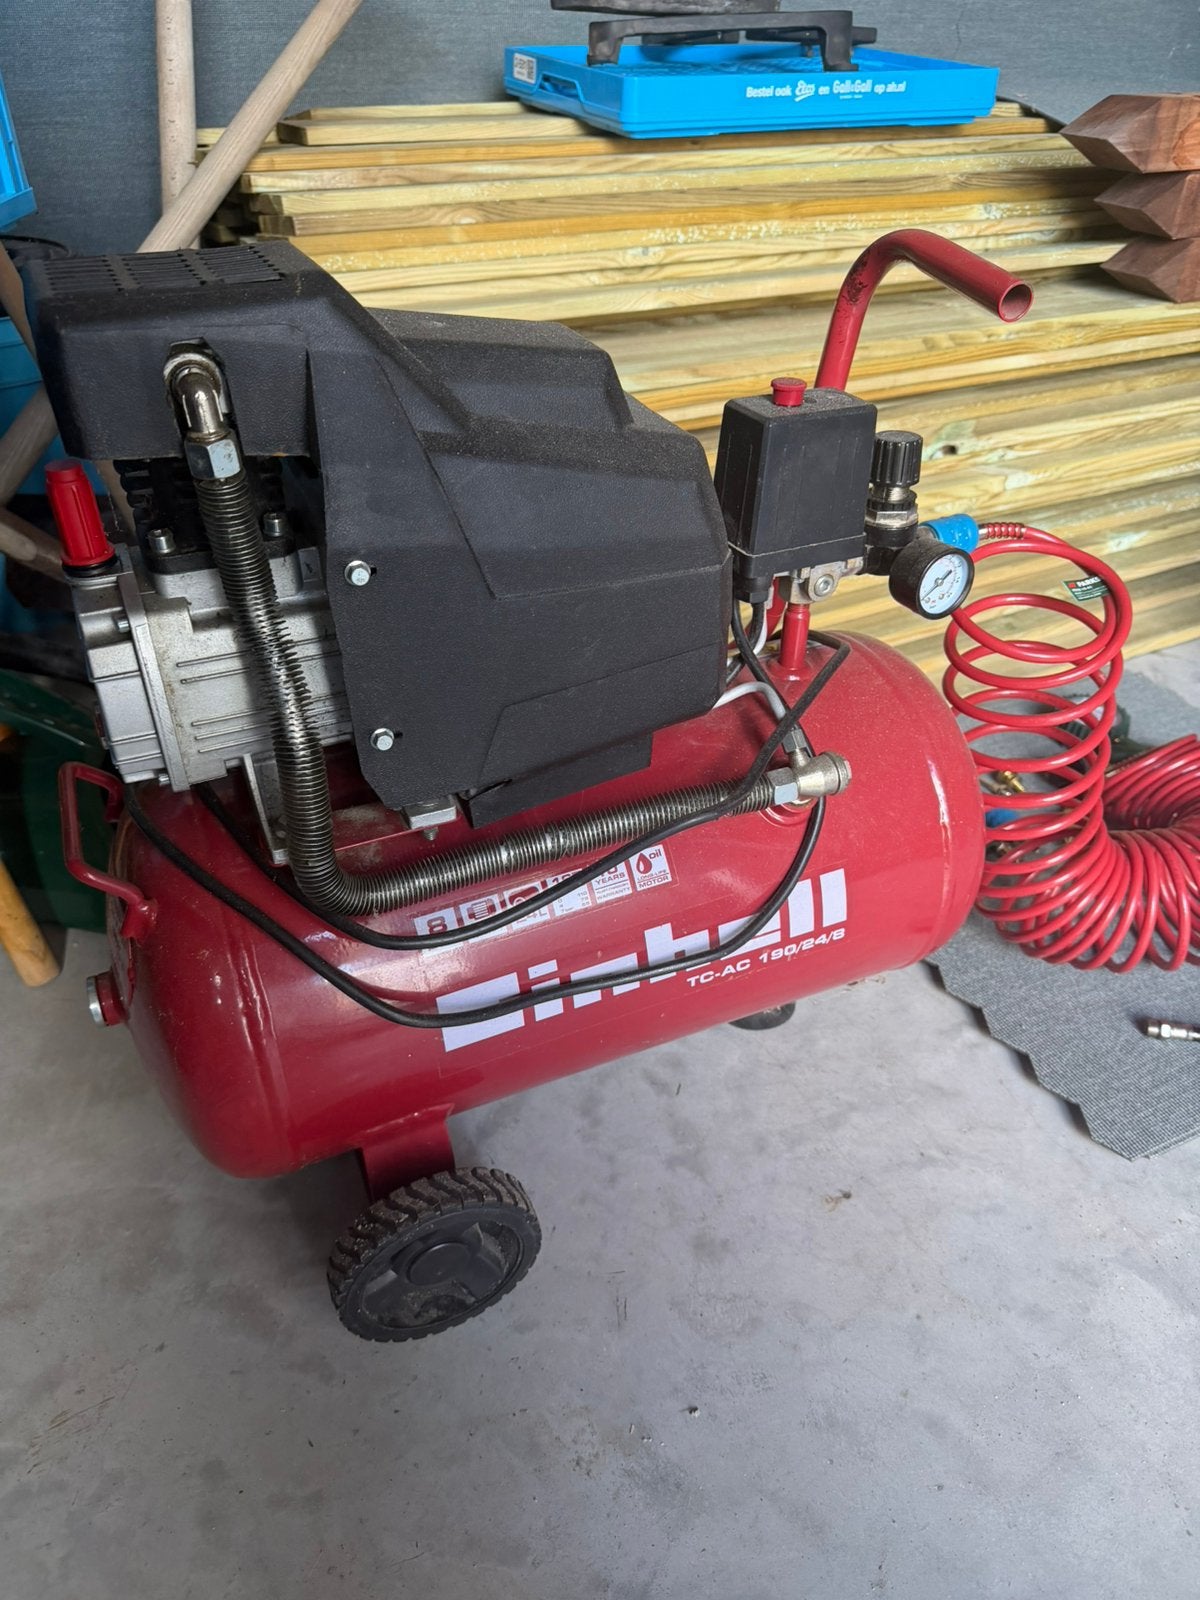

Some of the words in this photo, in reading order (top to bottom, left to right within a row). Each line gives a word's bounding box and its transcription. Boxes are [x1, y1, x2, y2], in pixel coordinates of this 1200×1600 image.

[745, 85, 774, 98] Bestel
[775, 85, 792, 97] ook
[818, 86, 831, 95] en
[874, 84, 886, 95] op
[886, 80, 907, 93] ah.nl
[648, 848, 662, 860] oil
[595, 872, 626, 885] YEARS
[638, 875, 669, 889] MOTOR
[597, 886, 630, 900] WARRANTY
[437, 868, 848, 1053] Einhell
[686, 958, 752, 988] TC-AC
[758, 927, 847, 965] 190/24/8
